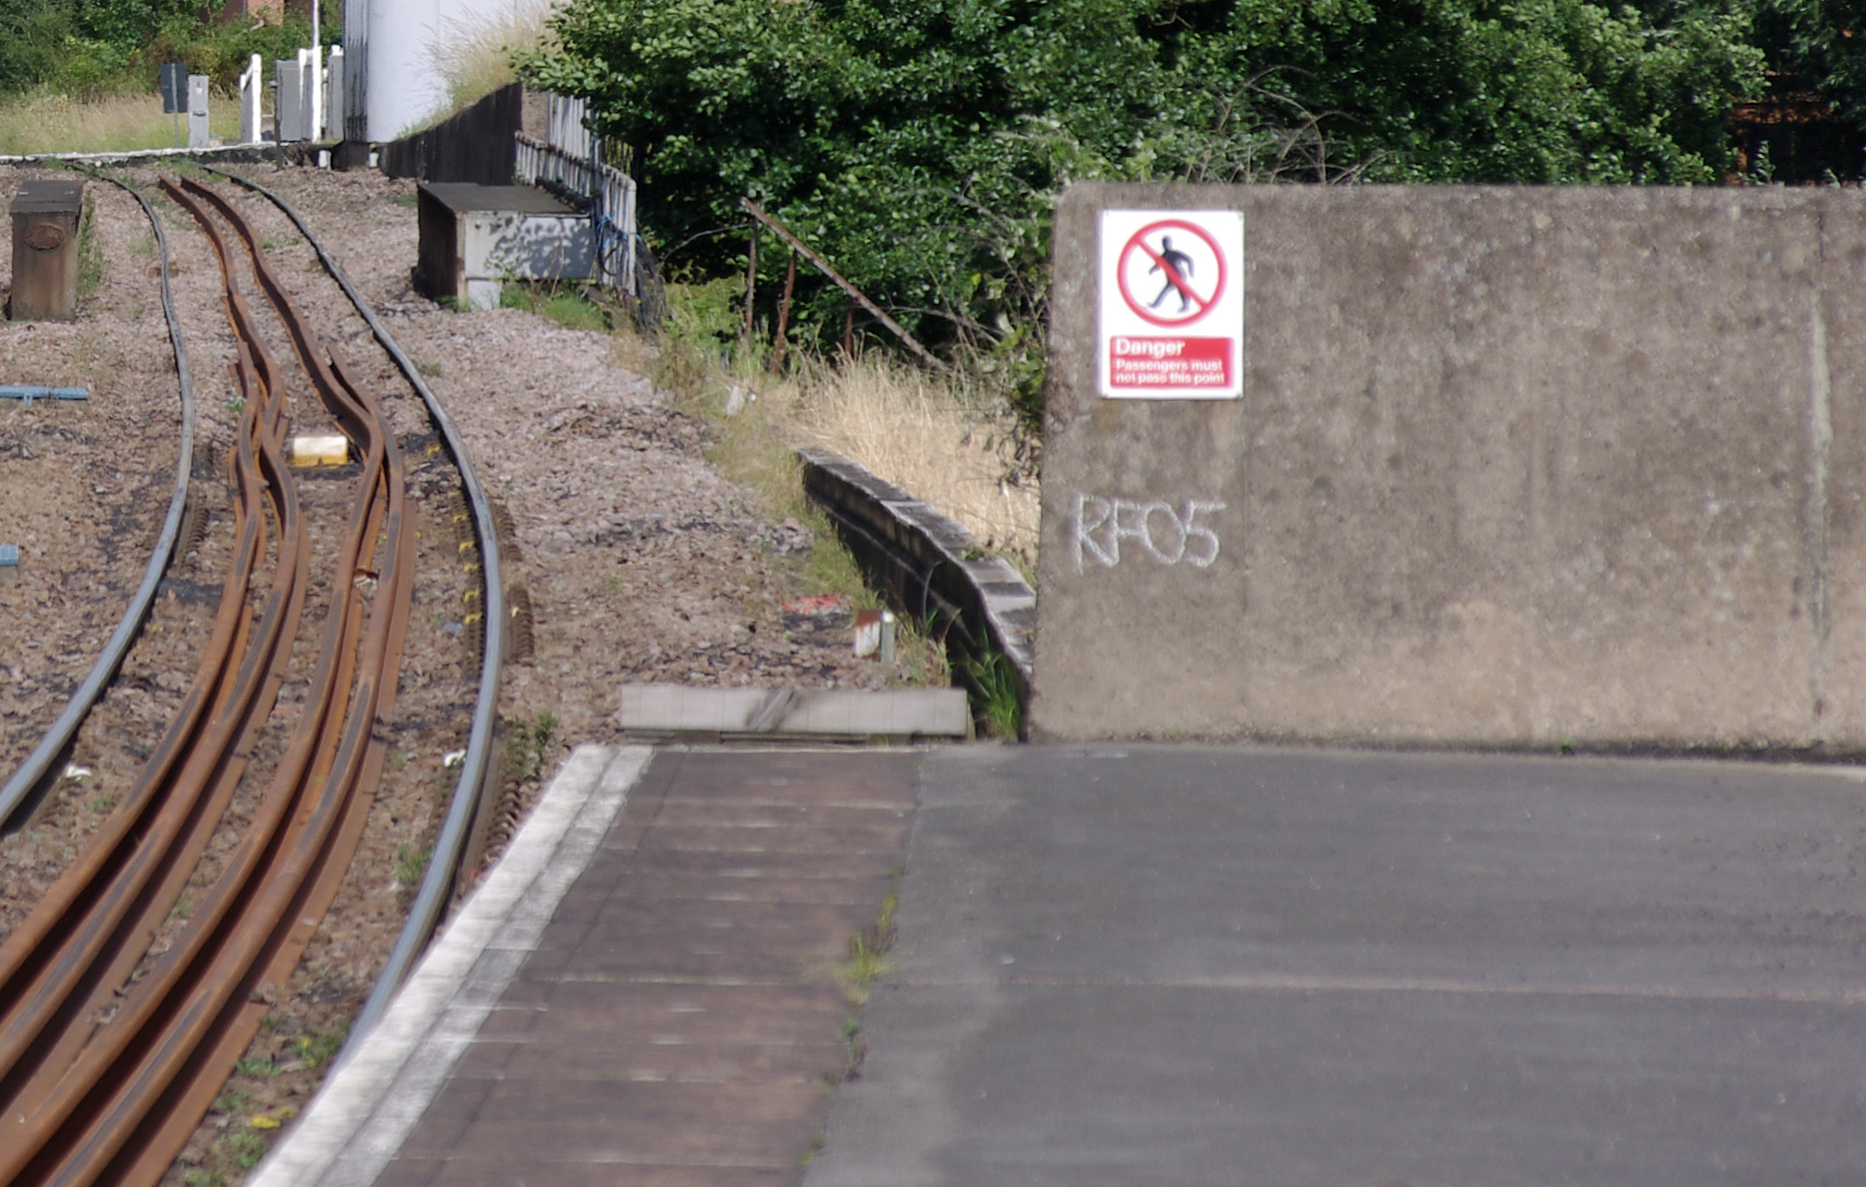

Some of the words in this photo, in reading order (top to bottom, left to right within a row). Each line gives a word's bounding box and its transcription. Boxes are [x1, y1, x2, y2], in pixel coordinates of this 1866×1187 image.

[1116, 338, 1185, 359] Danger
[1116, 359, 1188, 372] Passengers
[1191, 359, 1223, 371] must
[1116, 372, 1136, 383] not
[1138, 373, 1167, 384] pass
[1170, 372, 1191, 383] this
[1194, 372, 1225, 385] point
